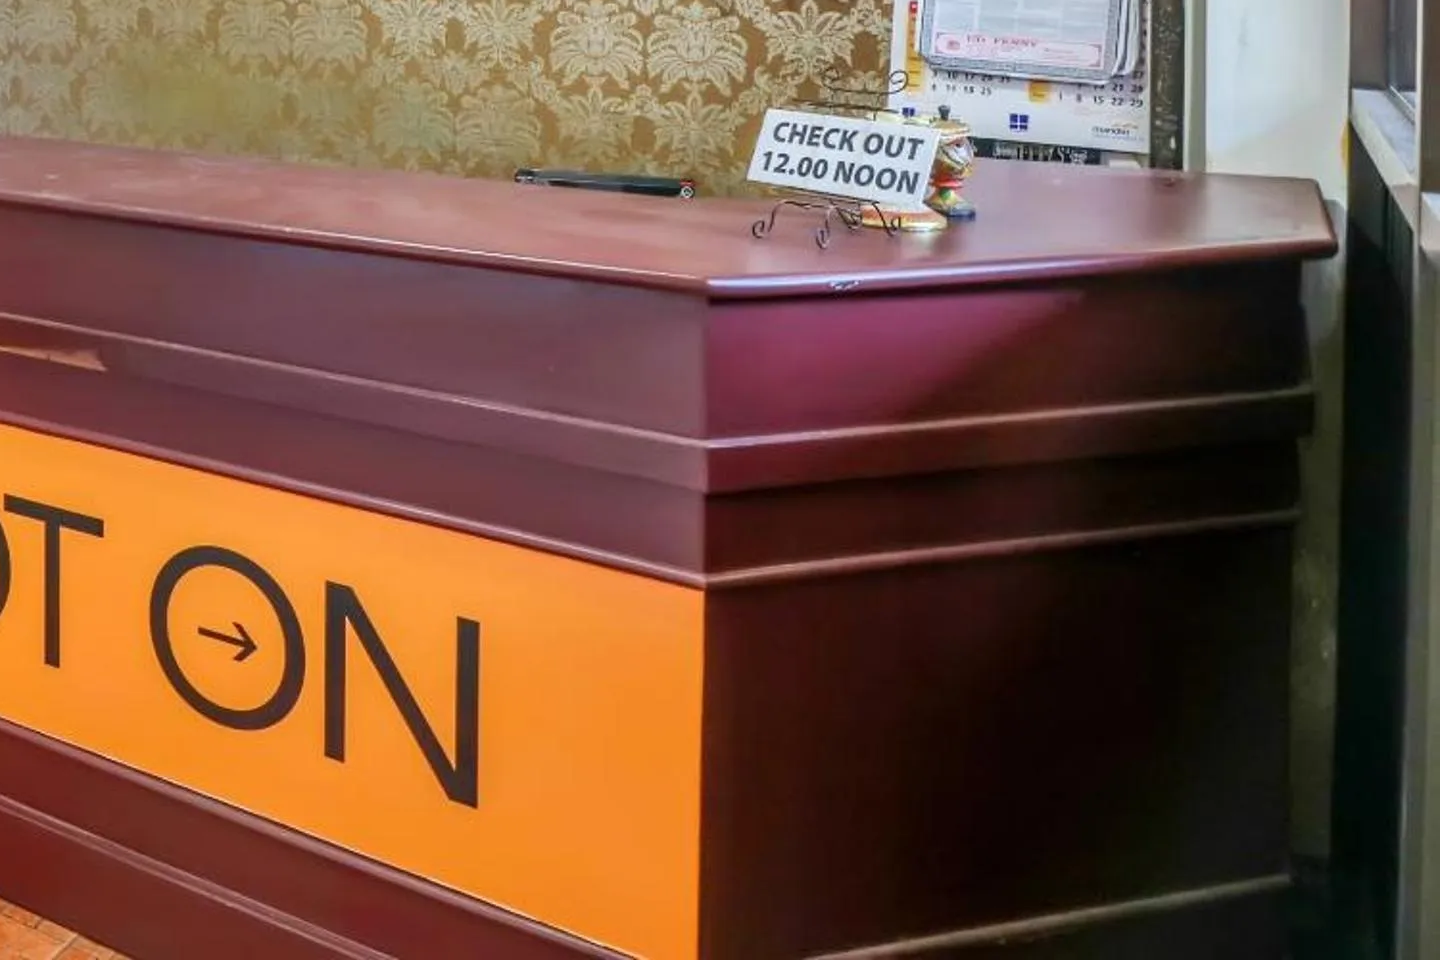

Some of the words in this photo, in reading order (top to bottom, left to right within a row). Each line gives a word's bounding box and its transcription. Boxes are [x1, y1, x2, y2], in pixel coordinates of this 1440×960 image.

[773, 122, 858, 152] CHECK
[863, 133, 924, 160] OUT
[762, 151, 828, 179] 12.00
[833, 161, 920, 194] NOON
[149, 545, 480, 810] ON
